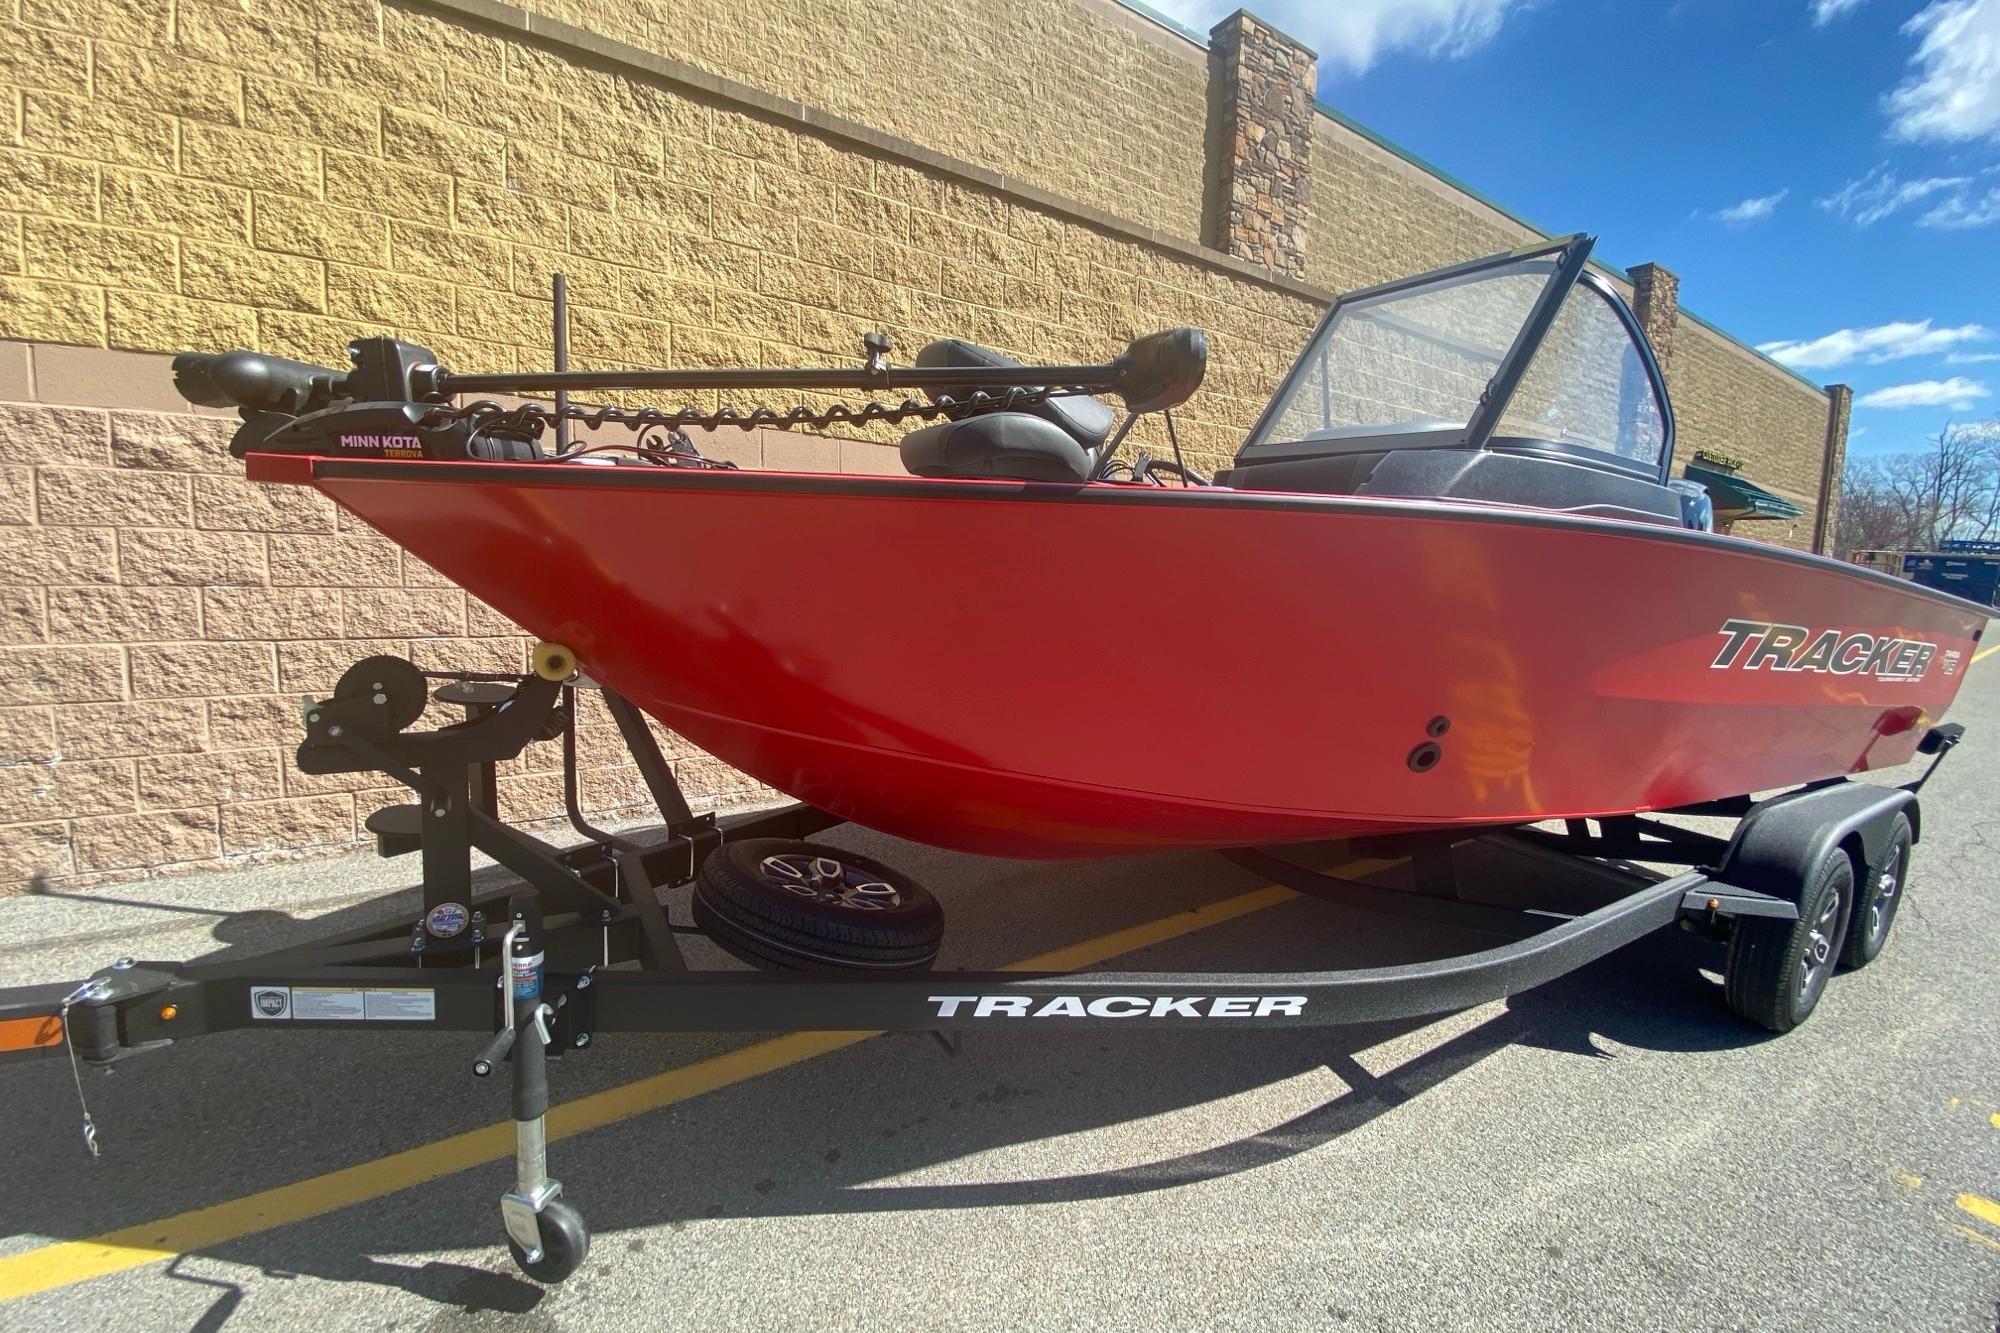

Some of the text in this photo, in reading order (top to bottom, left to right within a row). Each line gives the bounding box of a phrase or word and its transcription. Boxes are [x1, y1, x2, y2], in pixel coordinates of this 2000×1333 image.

[340, 435, 422, 449] MINN KOTA
[384, 449, 423, 458] TERROVA
[1710, 618, 1937, 677] TRACKER
[260, 998, 283, 1008] IMPACT
[928, 996, 1308, 1018] TRACKER
